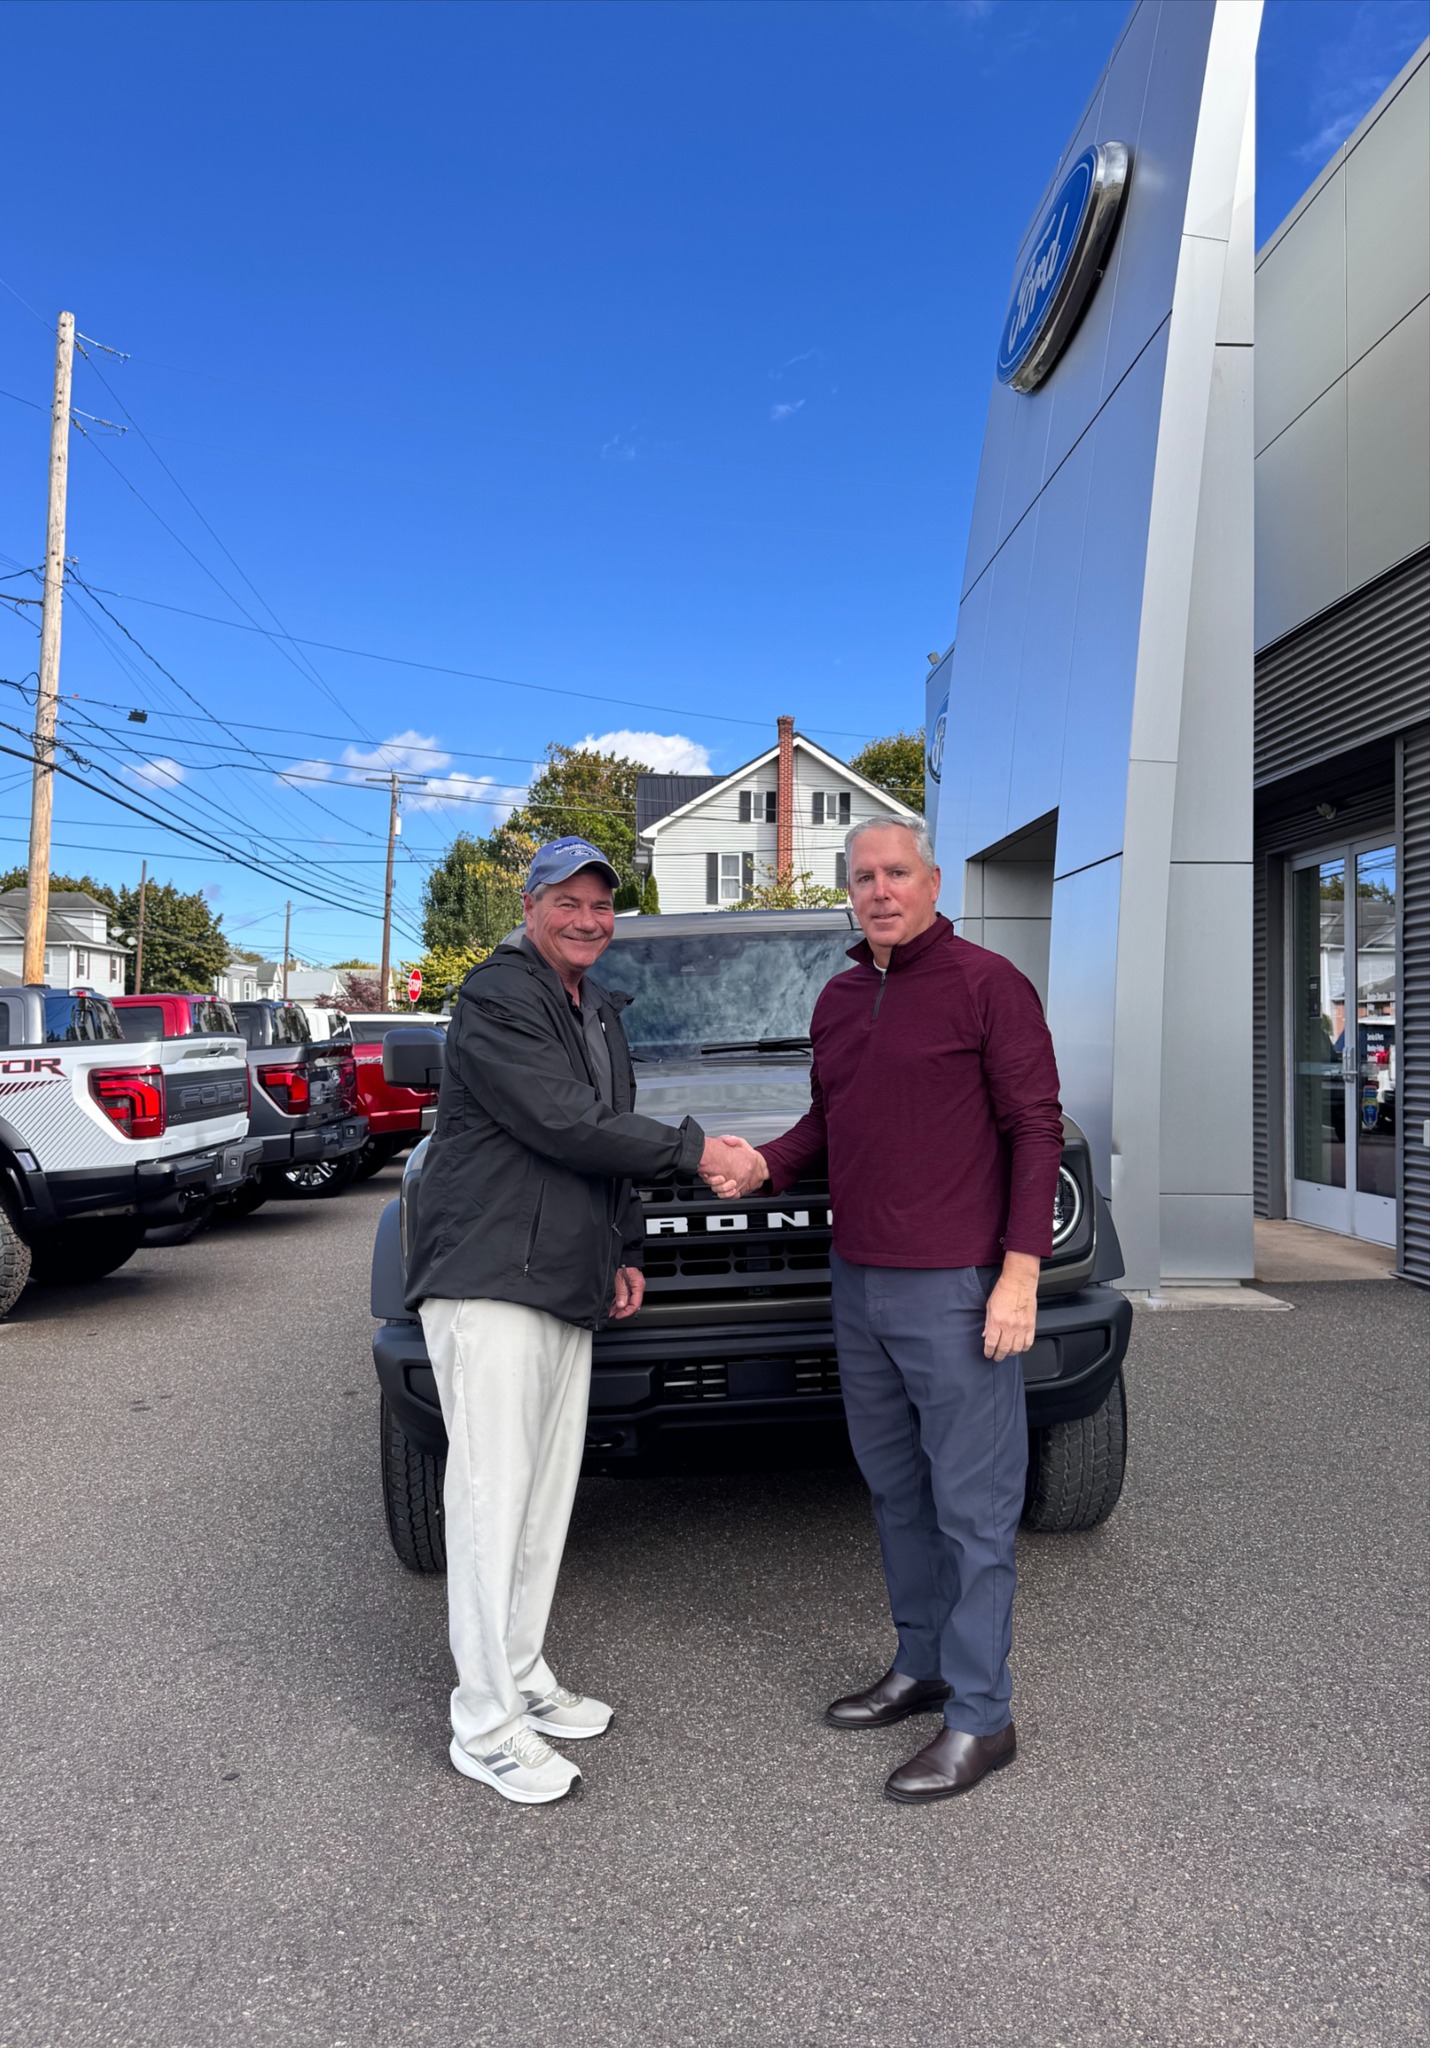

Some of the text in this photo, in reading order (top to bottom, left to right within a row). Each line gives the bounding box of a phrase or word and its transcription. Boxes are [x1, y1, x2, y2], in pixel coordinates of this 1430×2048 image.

[1008, 202, 1069, 354] Ford
[0, 1058, 67, 1078] OR
[180, 1083, 244, 1109] FORD
[646, 1209, 833, 1235] RON
